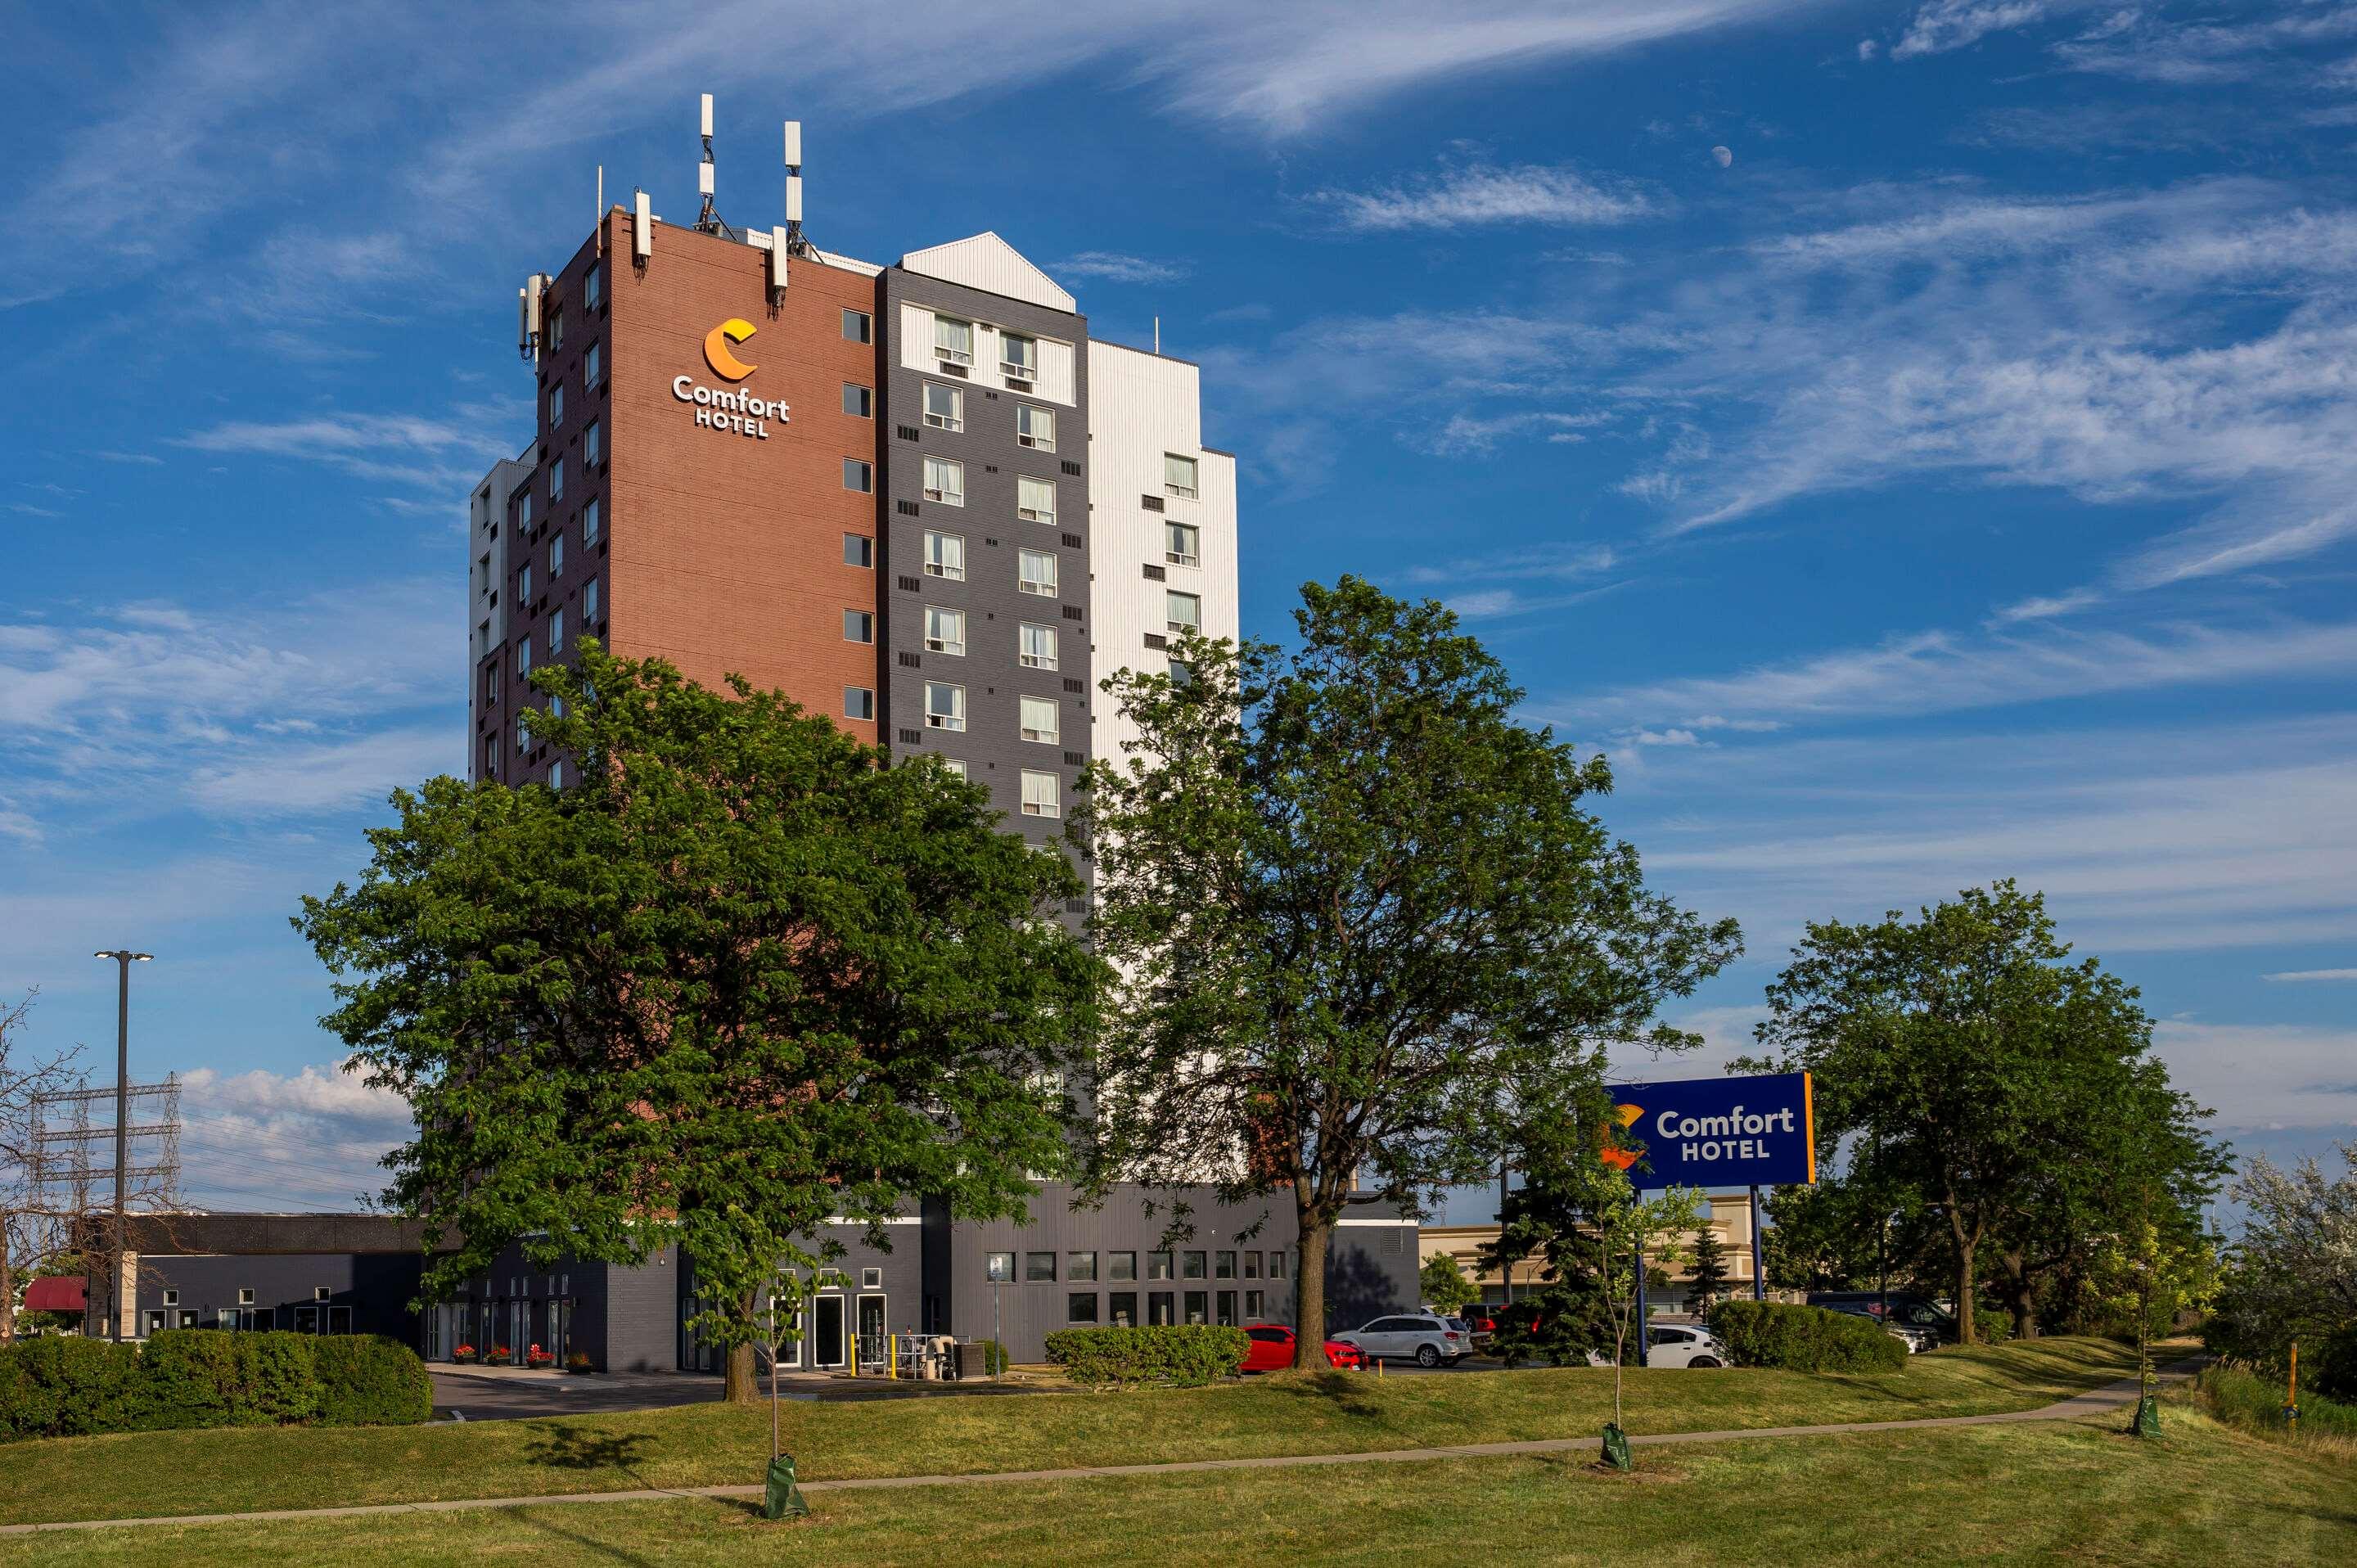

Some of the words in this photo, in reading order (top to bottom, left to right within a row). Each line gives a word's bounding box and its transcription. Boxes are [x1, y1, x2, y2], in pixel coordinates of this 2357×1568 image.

[672, 375, 790, 422] Comfort
[696, 408, 768, 438] HOTEL
[1656, 1106, 1794, 1138] Comfort
[1682, 1139, 1770, 1161] HOTEL
